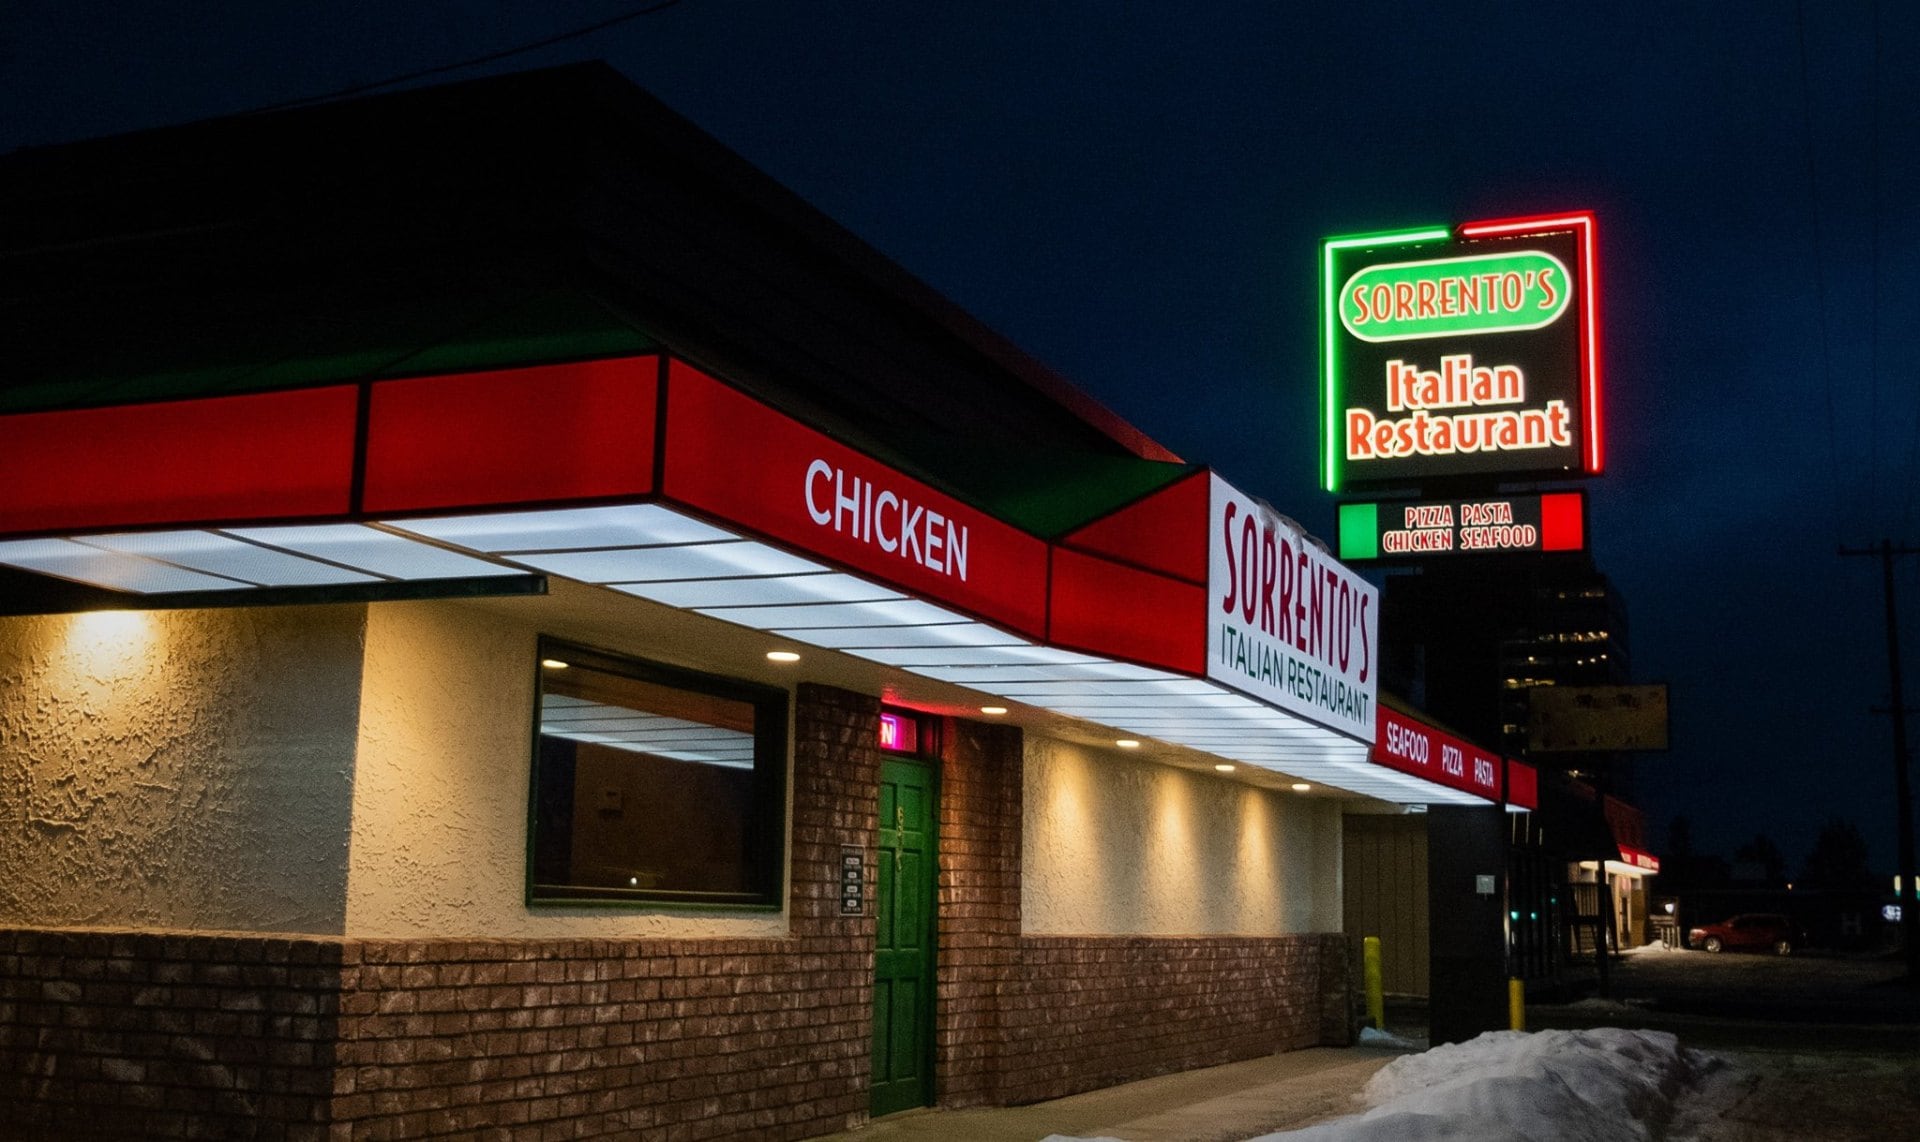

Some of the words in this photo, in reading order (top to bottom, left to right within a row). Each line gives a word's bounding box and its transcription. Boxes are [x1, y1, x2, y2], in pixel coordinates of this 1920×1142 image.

[1353, 269, 1559, 325] SORRENTO'S
[1387, 354, 1524, 412] Italian
[1347, 401, 1571, 460] Restaurant
[804, 458, 968, 582] CHICKEN
[1383, 524, 1453, 553] CHICKEN
[1460, 524, 1537, 550] SEAFOOD
[1404, 504, 1454, 529] PIZZA
[1461, 502, 1513, 525] PASTA
[1222, 500, 1369, 684] SORRENTO'S
[1221, 623, 1284, 690] ITALIAN
[1287, 655, 1369, 726] RESTAURANT
[1386, 720, 1429, 765] SEAFOOD
[1442, 743, 1464, 777] PIZZA
[1474, 757, 1494, 788] PASTA
